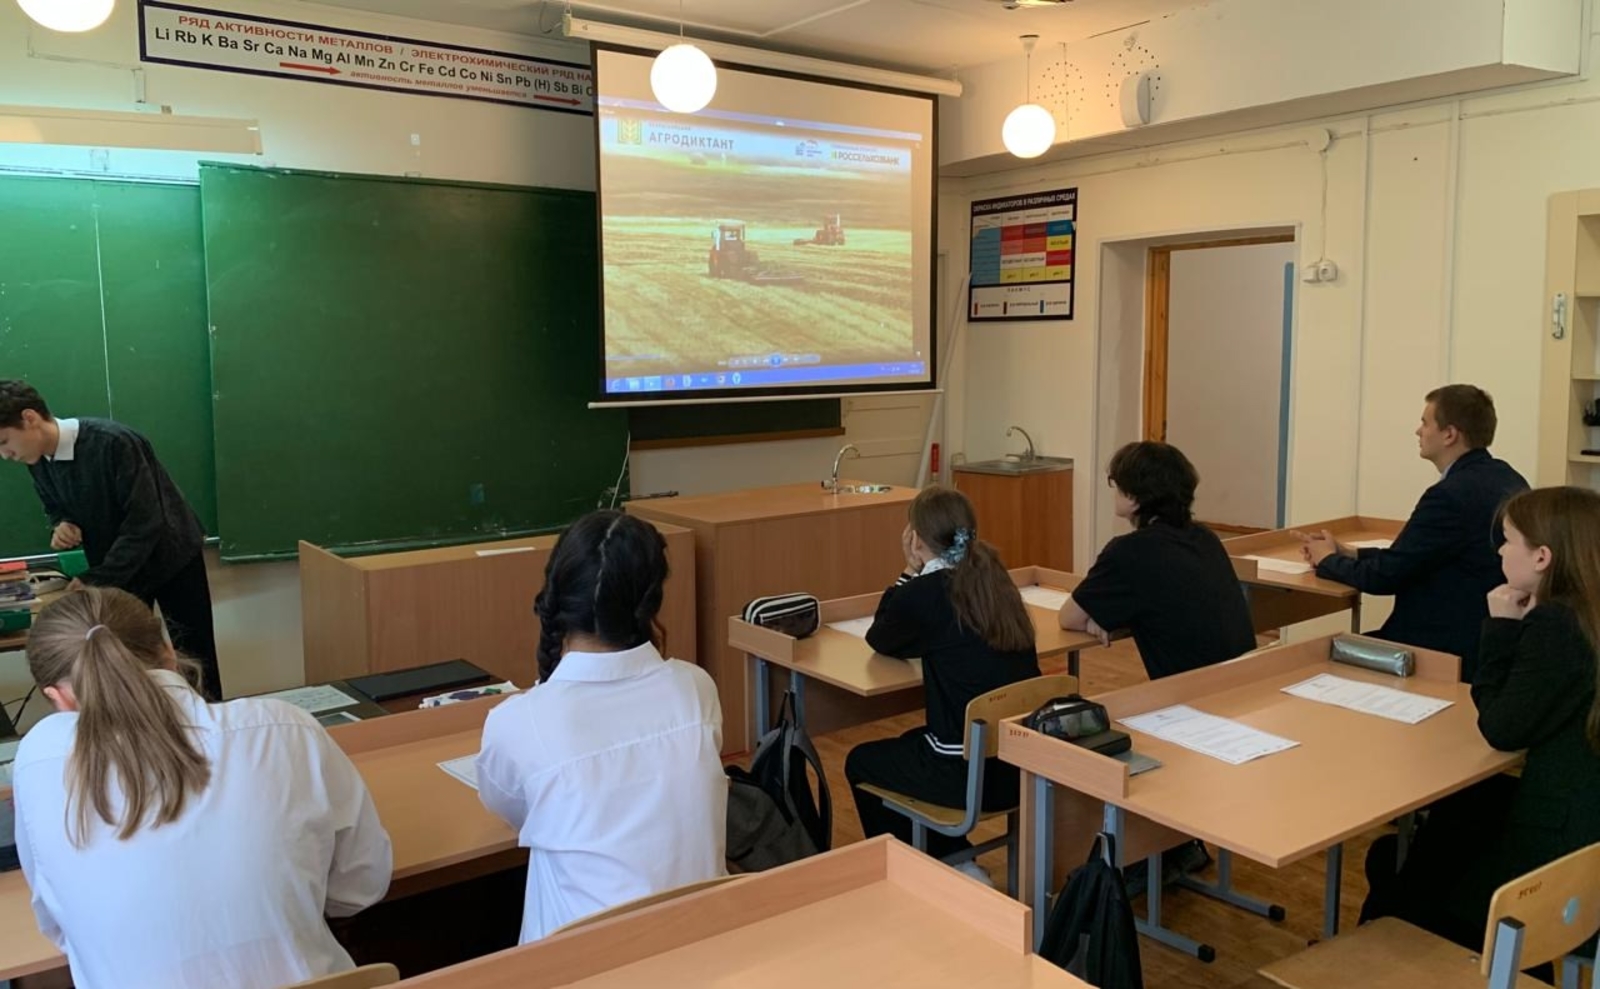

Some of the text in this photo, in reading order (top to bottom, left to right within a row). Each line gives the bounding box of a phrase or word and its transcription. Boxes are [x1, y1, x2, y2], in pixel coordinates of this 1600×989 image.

[155, 27, 170, 41] Li
[175, 29, 197, 44] Rb
[202, 33, 213, 46] K
[218, 35, 239, 50] Ba
[243, 39, 260, 52] Sr
[264, 41, 283, 56] Ca
[288, 45, 307, 59] Na
[312, 48, 332, 64] Mg
[336, 52, 351, 64] Al
[354, 55, 374, 68] Mn
[378, 58, 395, 71] Zn
[400, 60, 415, 73] Cr
[419, 63, 435, 75] Fe
[438, 65, 456, 78] Cd
[460, 67, 477, 80] Co
[480, 70, 493, 82] Ni
[496, 73, 512, 85] Sn
[515, 75, 531, 88] Pb
[534, 78, 551, 93] (H)
[554, 82, 569, 94] Sb
[572, 84, 583, 96] Bi
[178, 15, 210, 30] РЯД
[214, 21, 314, 43] АКТИВНОСТИ
[318, 35, 394, 54] МЕТАЛЛОВ
[411, 48, 549, 75] ЭЛЕКТРОХИМИЧЕСКИЙ
[551, 69, 575, 81] РЯД
[350, 70, 527, 98] активность металлов уменьшается
[649, 132, 734, 150] АГРОДИКТАНТ
